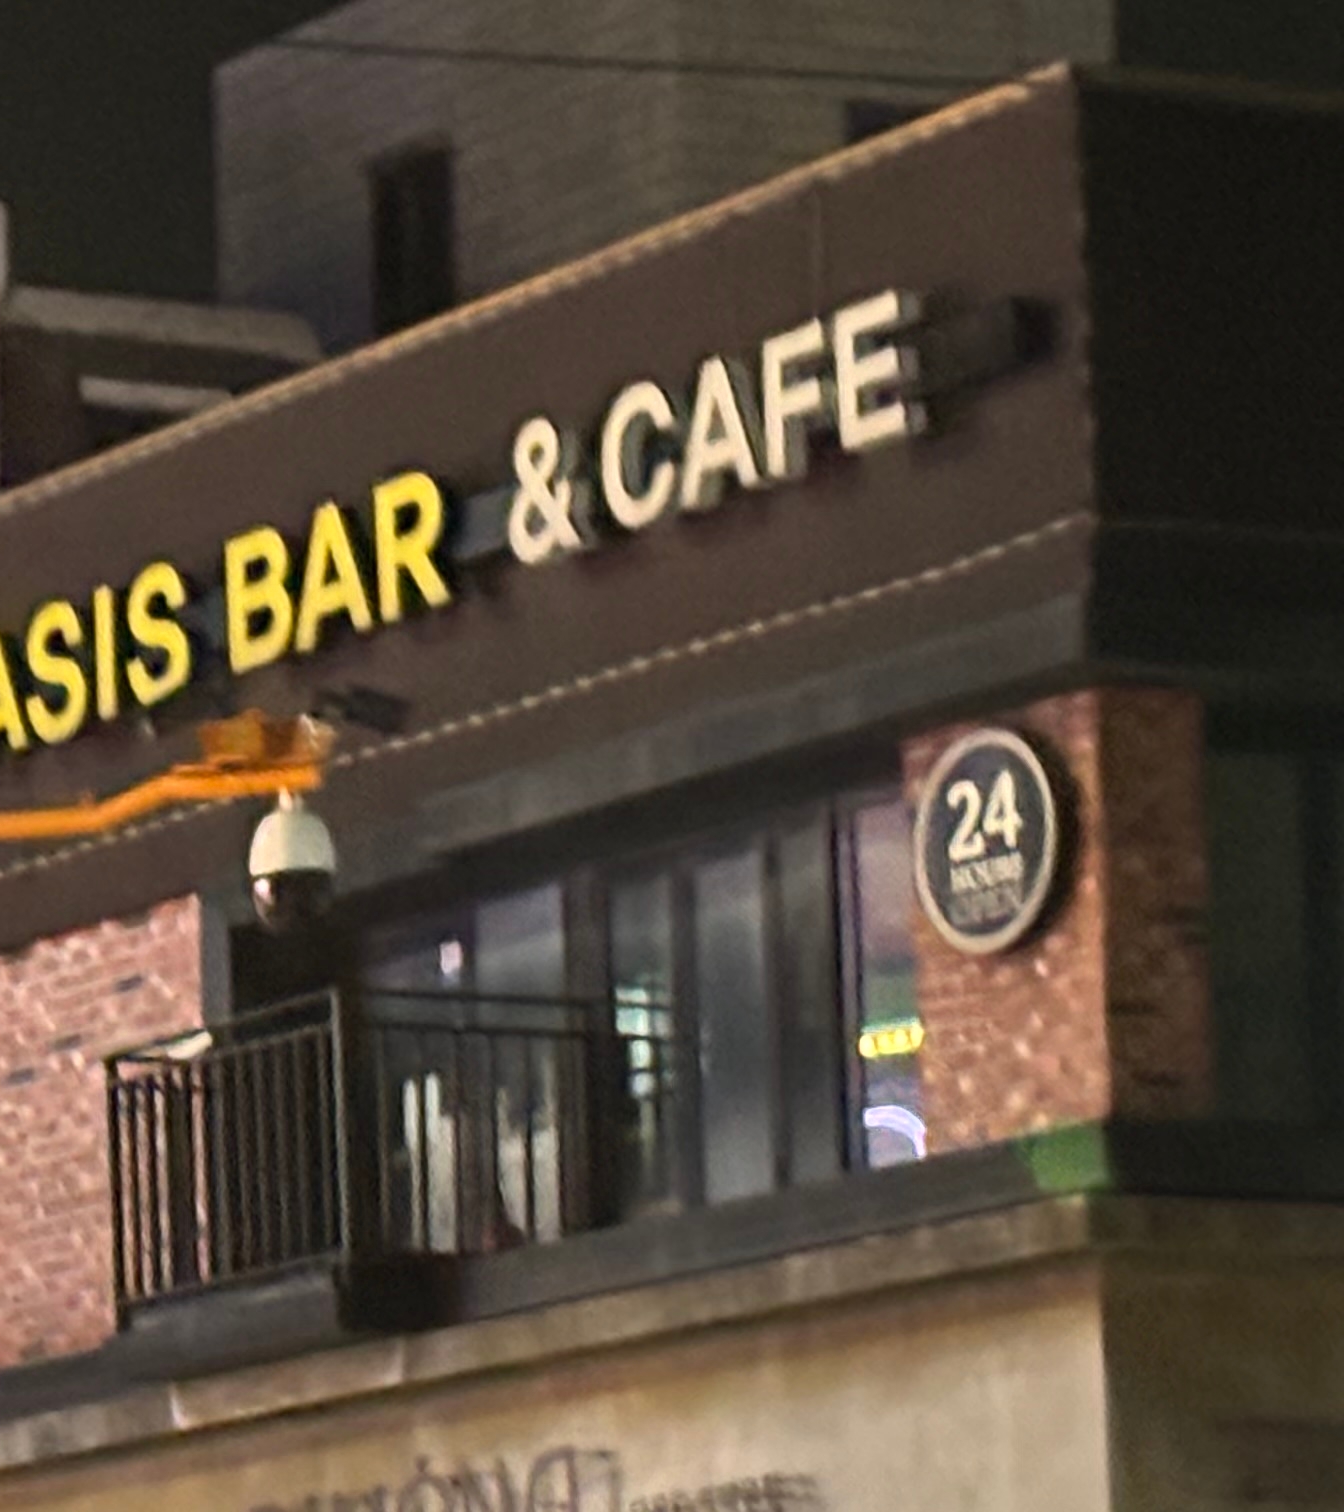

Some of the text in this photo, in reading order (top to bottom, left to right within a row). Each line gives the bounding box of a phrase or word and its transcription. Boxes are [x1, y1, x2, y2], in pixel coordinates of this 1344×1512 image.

[224, 470, 452, 676] BAR
[507, 416, 582, 565] &
[600, 289, 909, 530] CAFE
[946, 768, 1024, 864] 24
